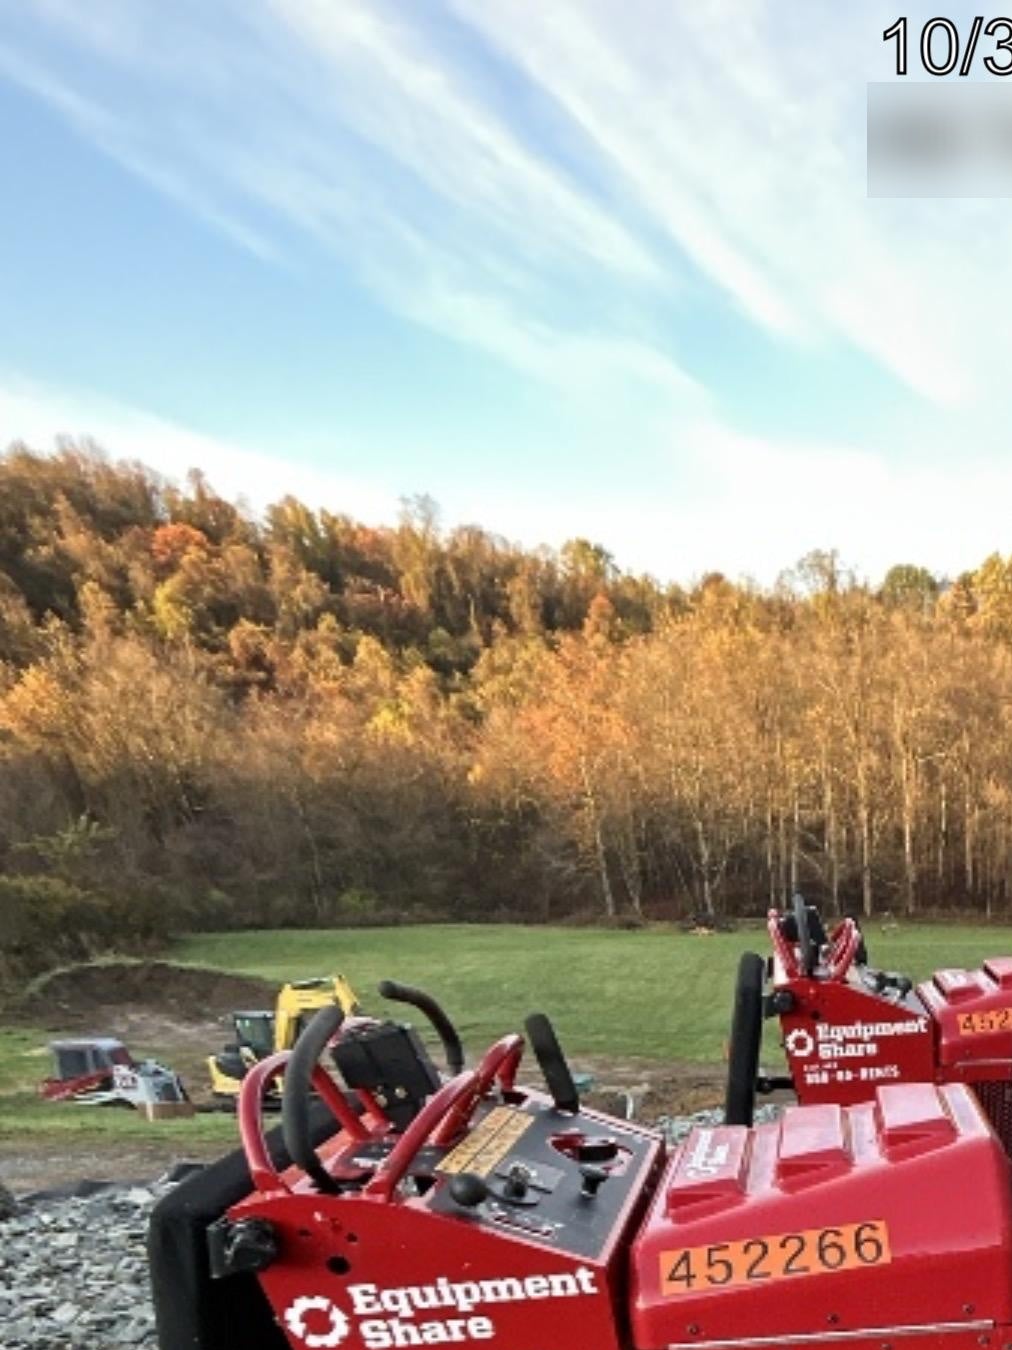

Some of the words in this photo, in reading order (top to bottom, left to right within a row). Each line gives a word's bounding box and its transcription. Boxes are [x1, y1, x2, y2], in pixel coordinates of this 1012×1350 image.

[816, 1017, 928, 1041] Equipment
[666, 1222, 883, 1289] 452266
[346, 1266, 599, 1317] Equipment
[360, 1315, 496, 1350] Share
